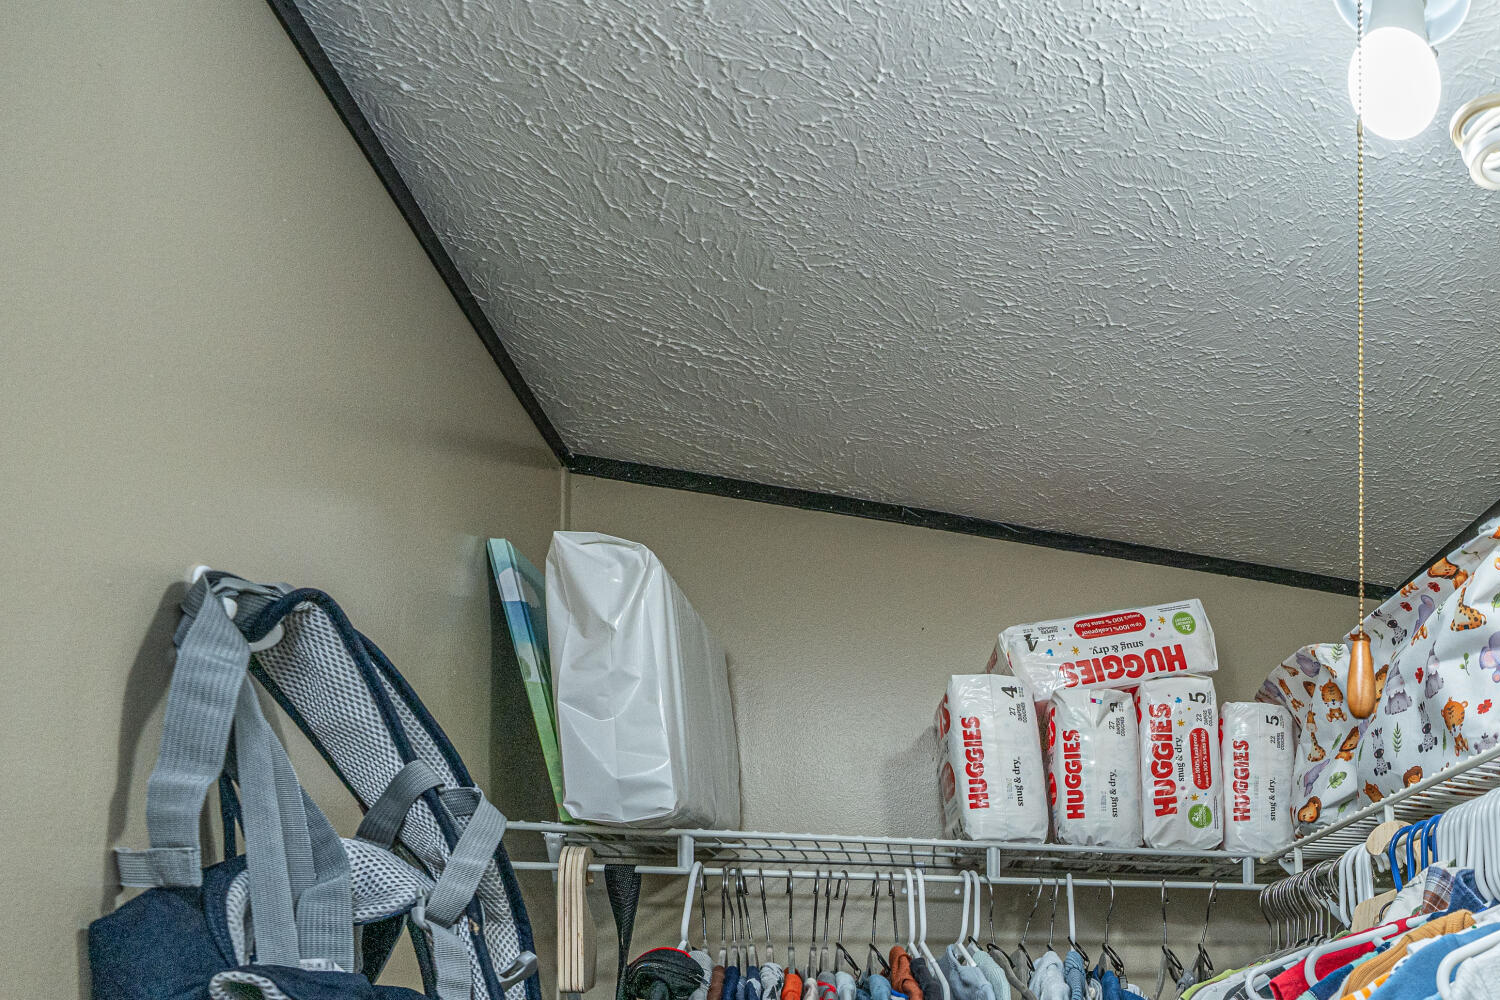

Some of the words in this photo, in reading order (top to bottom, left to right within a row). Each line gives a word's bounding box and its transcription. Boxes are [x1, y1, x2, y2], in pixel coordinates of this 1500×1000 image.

[1111, 644, 1118, 653] &
[1120, 640, 1144, 651] snug
[1058, 643, 1188, 688] HUGGIES
[1000, 685, 1018, 698] 4
[1188, 692, 1206, 704] 5
[1009, 707, 1016, 716] 27
[1196, 714, 1202, 722] 22
[1108, 721, 1115, 730] 27
[1266, 715, 1280, 726] 5
[1174, 738, 1182, 752] dry
[1270, 736, 1276, 744] 22
[960, 716, 990, 809] HUGGIES
[1148, 704, 1178, 816] HUGGIES
[1176, 754, 1183, 762] &
[1011, 760, 1021, 774] dry
[1177, 763, 1186, 782] snug
[1062, 729, 1085, 819] HUGGIES
[1108, 772, 1117, 786] dry
[1232, 740, 1250, 822] HUGGIES
[1268, 780, 1276, 793] dry
[1015, 785, 1024, 806] snug
[1110, 788, 1116, 796] &
[1110, 797, 1118, 818] snug
